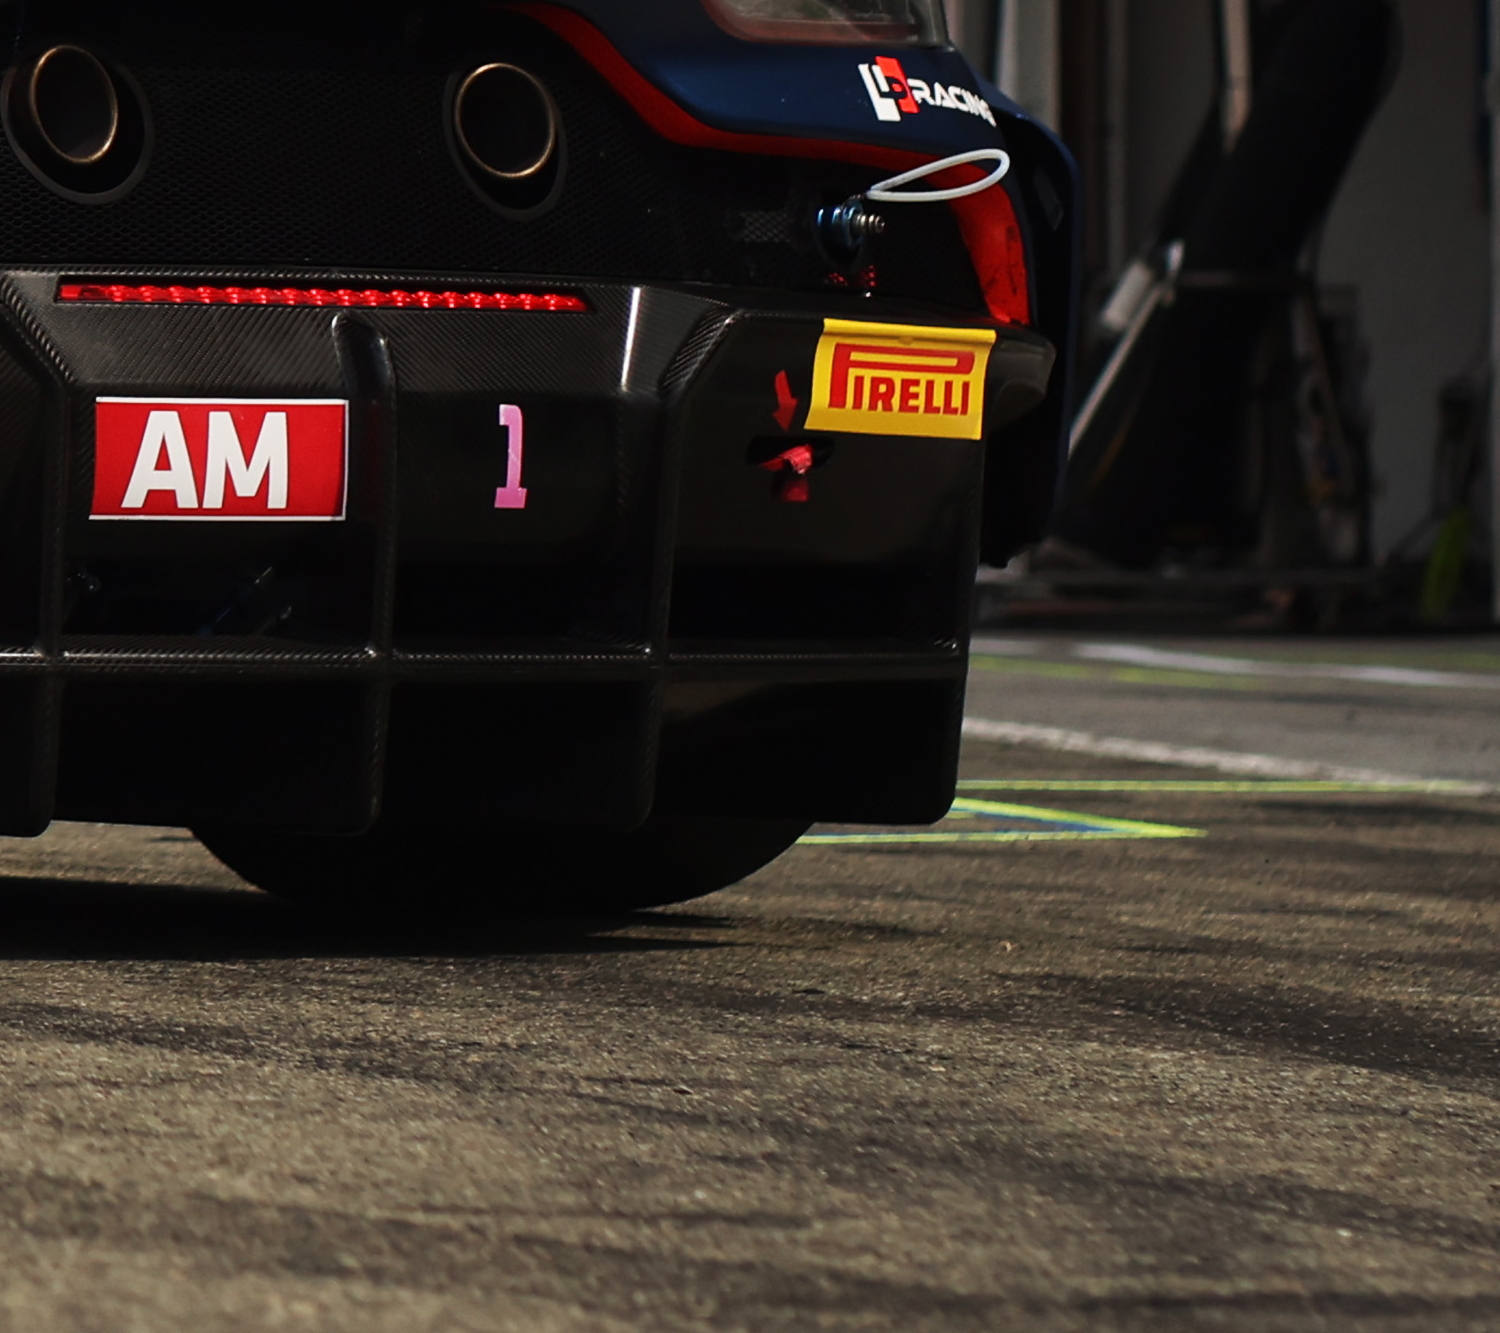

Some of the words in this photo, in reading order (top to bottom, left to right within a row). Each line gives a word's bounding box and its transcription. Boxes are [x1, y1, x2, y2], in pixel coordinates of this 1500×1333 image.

[907, 77, 997, 127] RACING
[828, 342, 977, 417] PIRELLI
[121, 409, 289, 510] AM
[494, 404, 527, 509] 1
